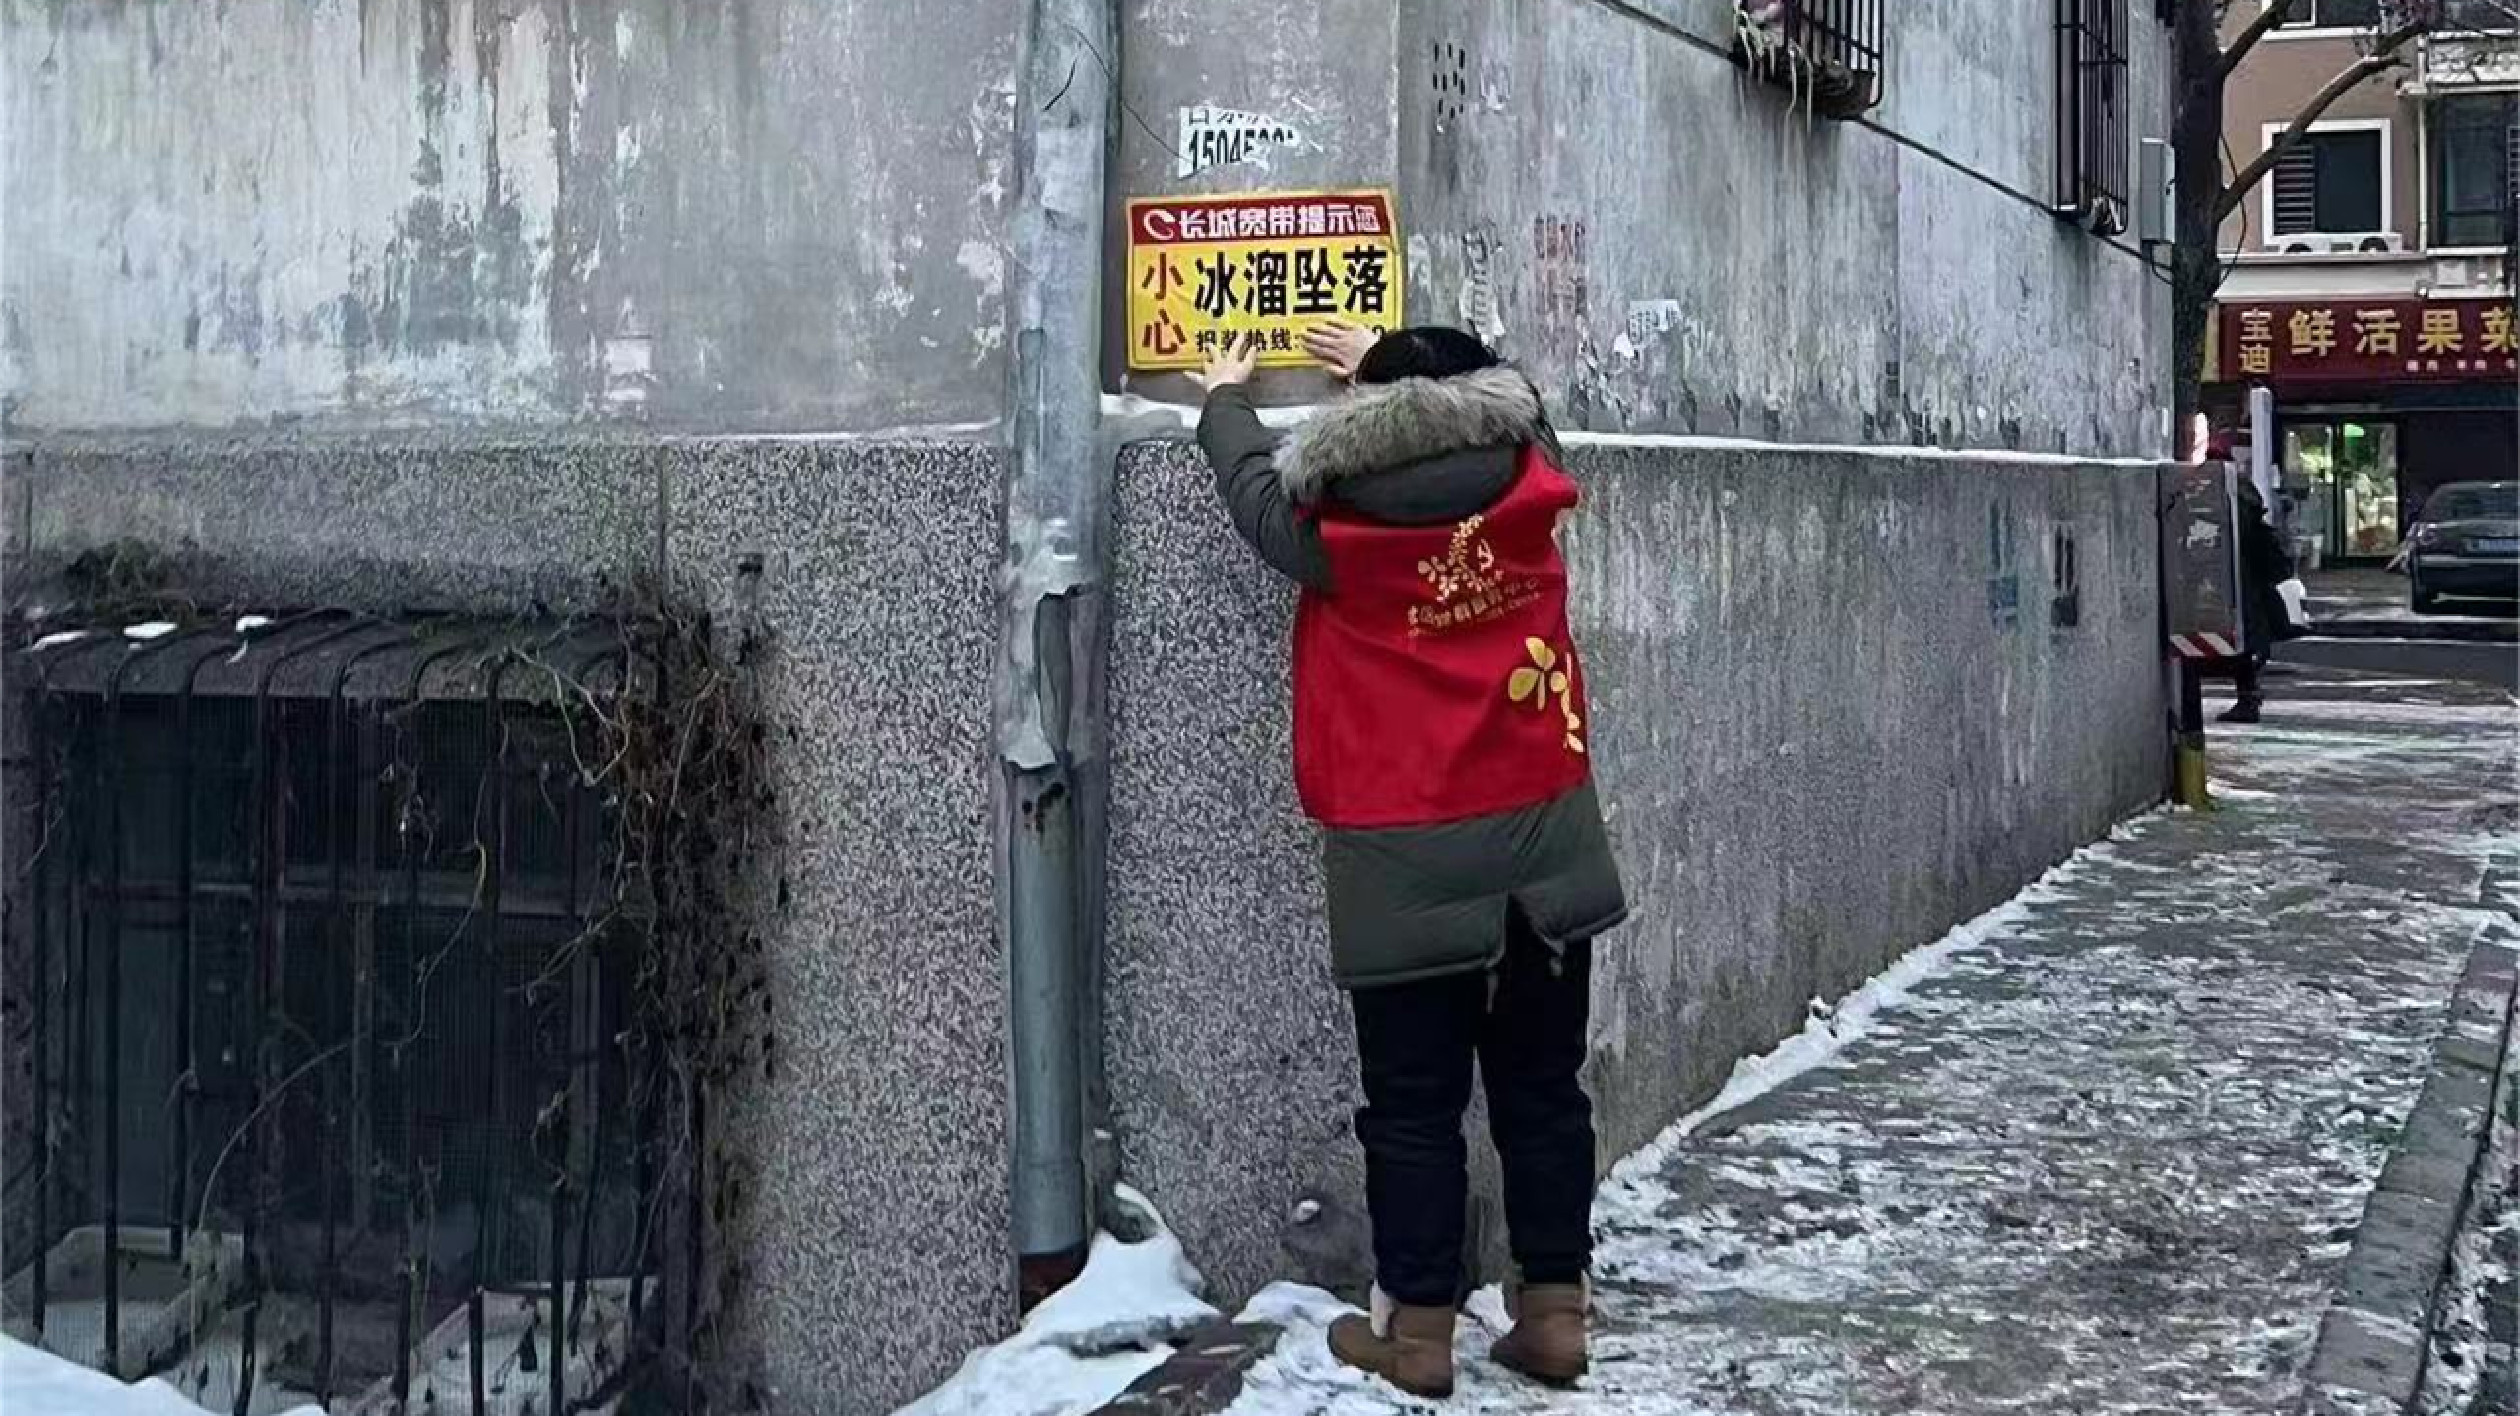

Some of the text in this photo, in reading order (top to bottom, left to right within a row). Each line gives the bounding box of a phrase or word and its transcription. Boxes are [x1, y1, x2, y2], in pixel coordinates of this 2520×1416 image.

[1142, 252, 1186, 355] 小心
[1194, 244, 1388, 318] 冰溜坠落
